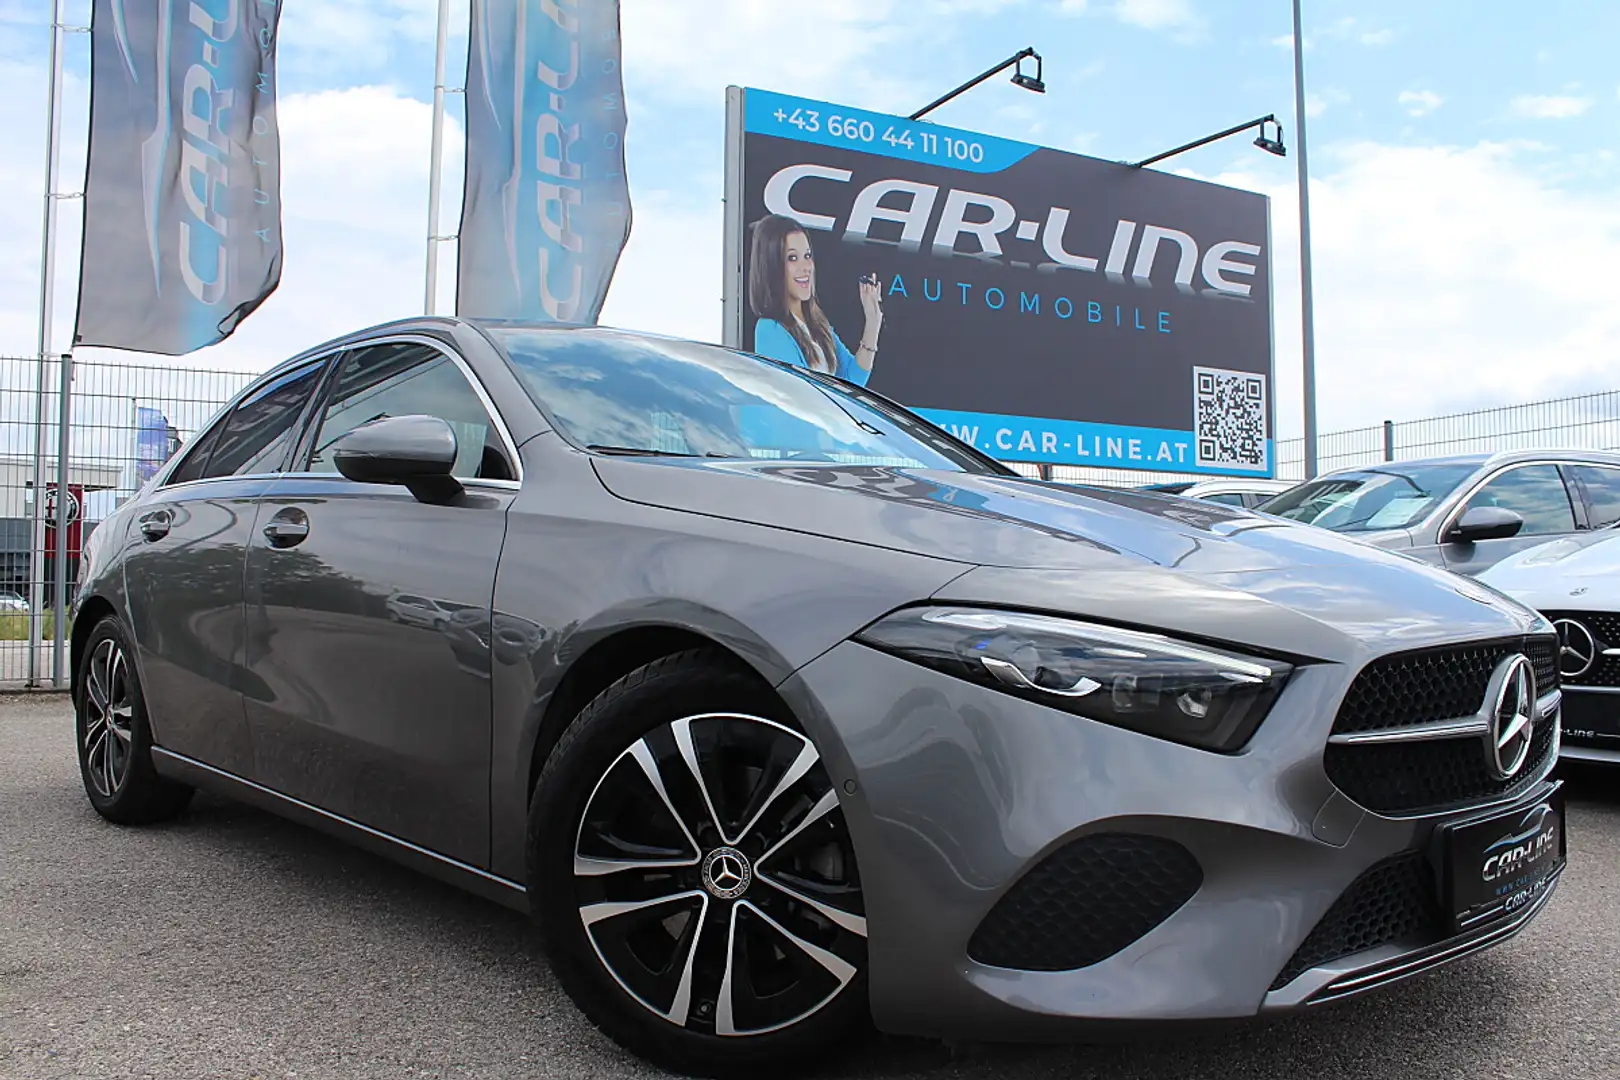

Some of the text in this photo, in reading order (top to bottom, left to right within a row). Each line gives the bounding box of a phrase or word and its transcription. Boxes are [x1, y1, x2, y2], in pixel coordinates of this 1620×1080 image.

[252, 0, 276, 242] AUTOMO
[774, 107, 984, 163] +43 660 44 11 100
[888, 273, 1172, 333] AUTOMOBILE
[940, 423, 1188, 463] W.CAR-LINE.AT
